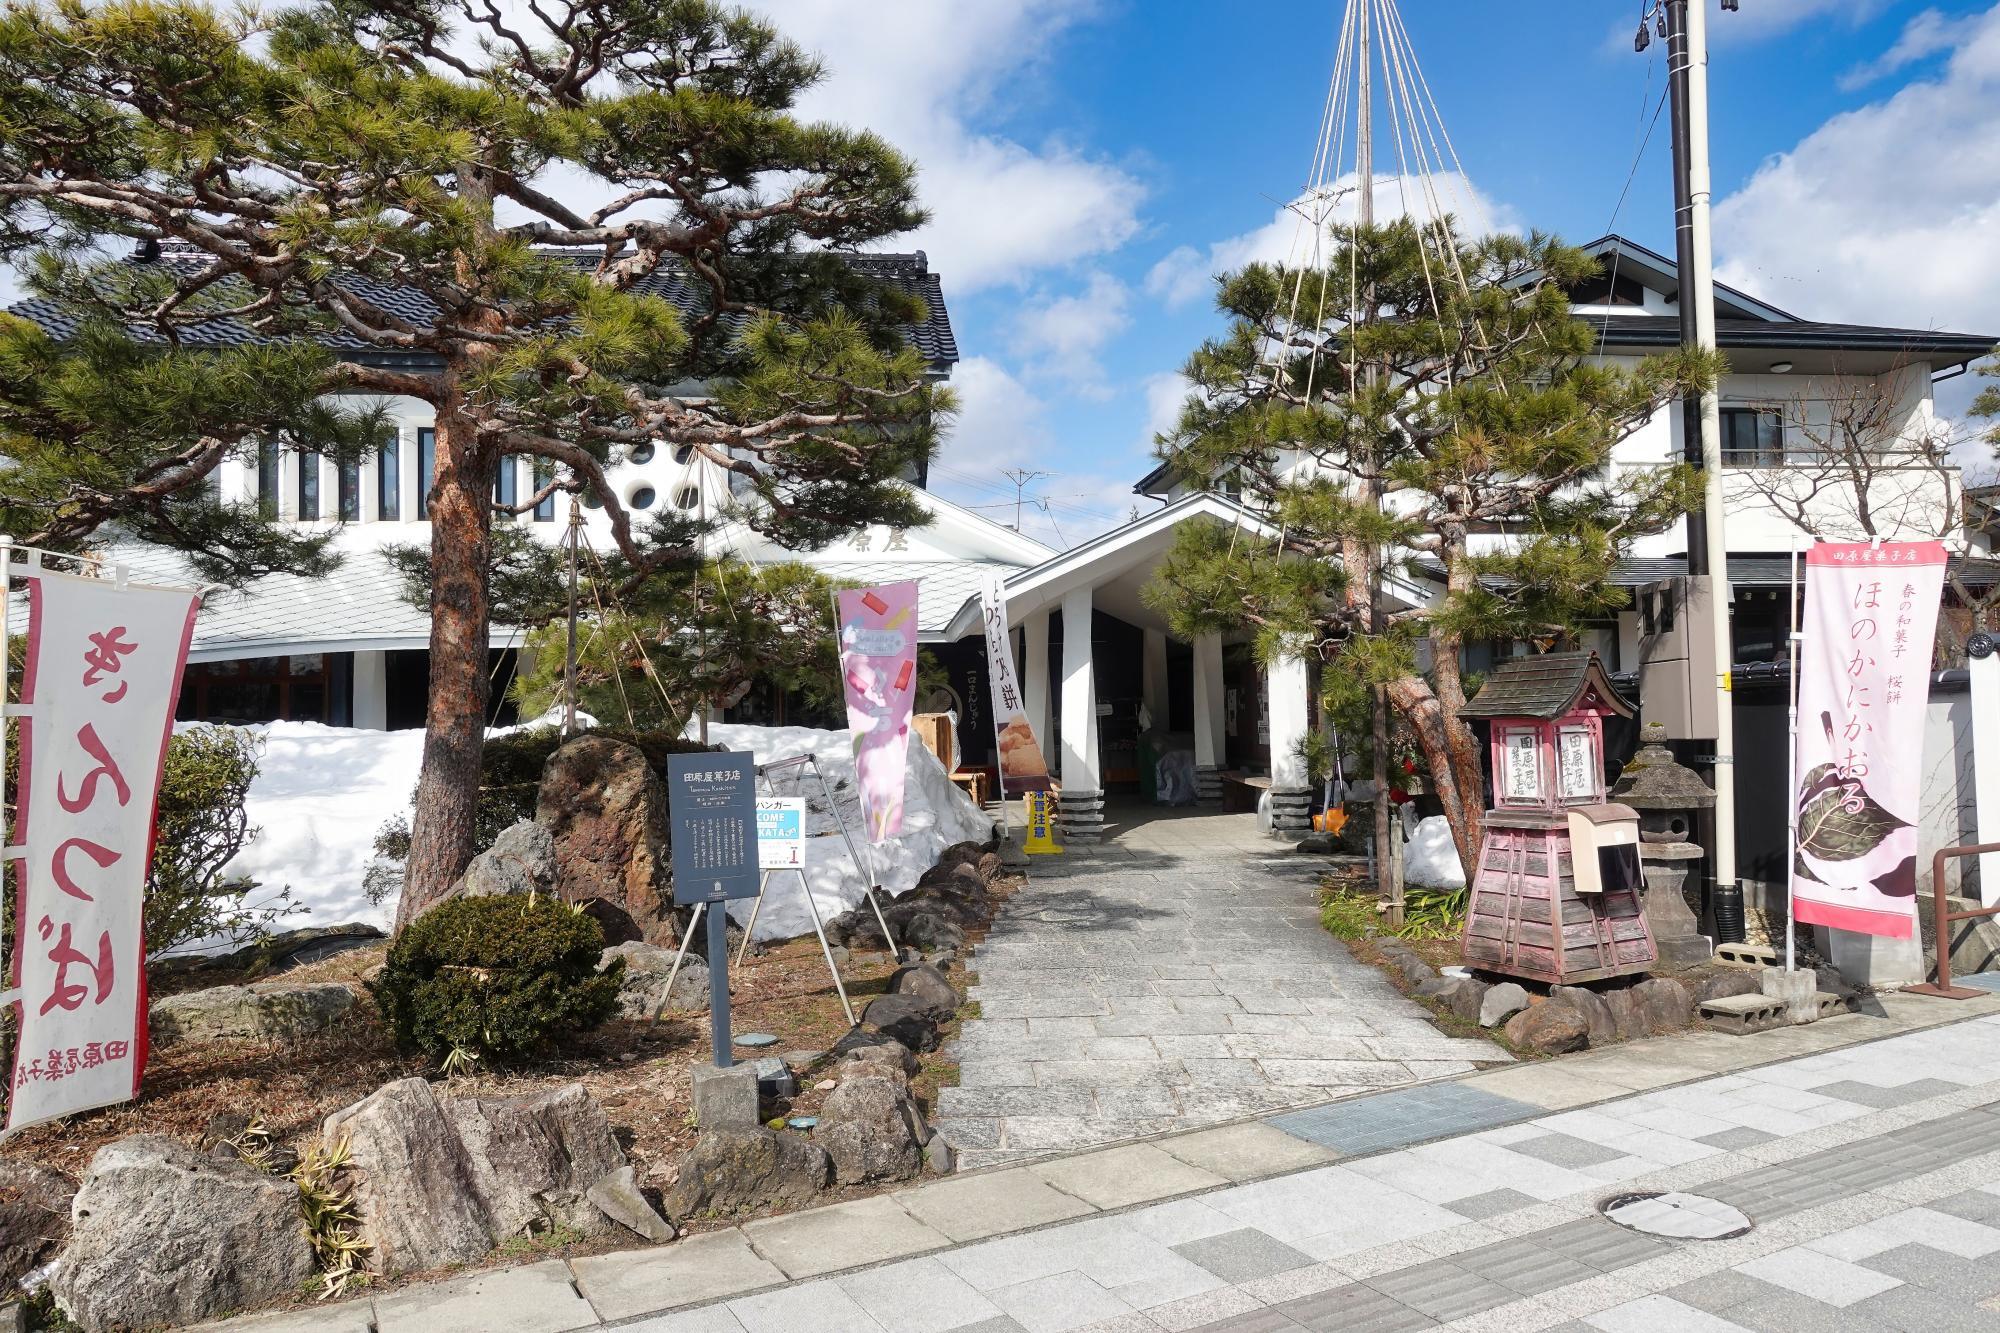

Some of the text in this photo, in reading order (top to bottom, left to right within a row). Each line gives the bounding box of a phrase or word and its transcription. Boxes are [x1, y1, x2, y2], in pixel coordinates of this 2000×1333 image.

[847, 526, 908, 552] 原屋
[1833, 549, 1917, 562] 田原屋菓子店
[1886, 583, 1917, 705] 春の和菓子 桜餅
[1840, 582, 1883, 814] ほのかにかおる
[683, 769, 741, 783] 田原屋菓子店
